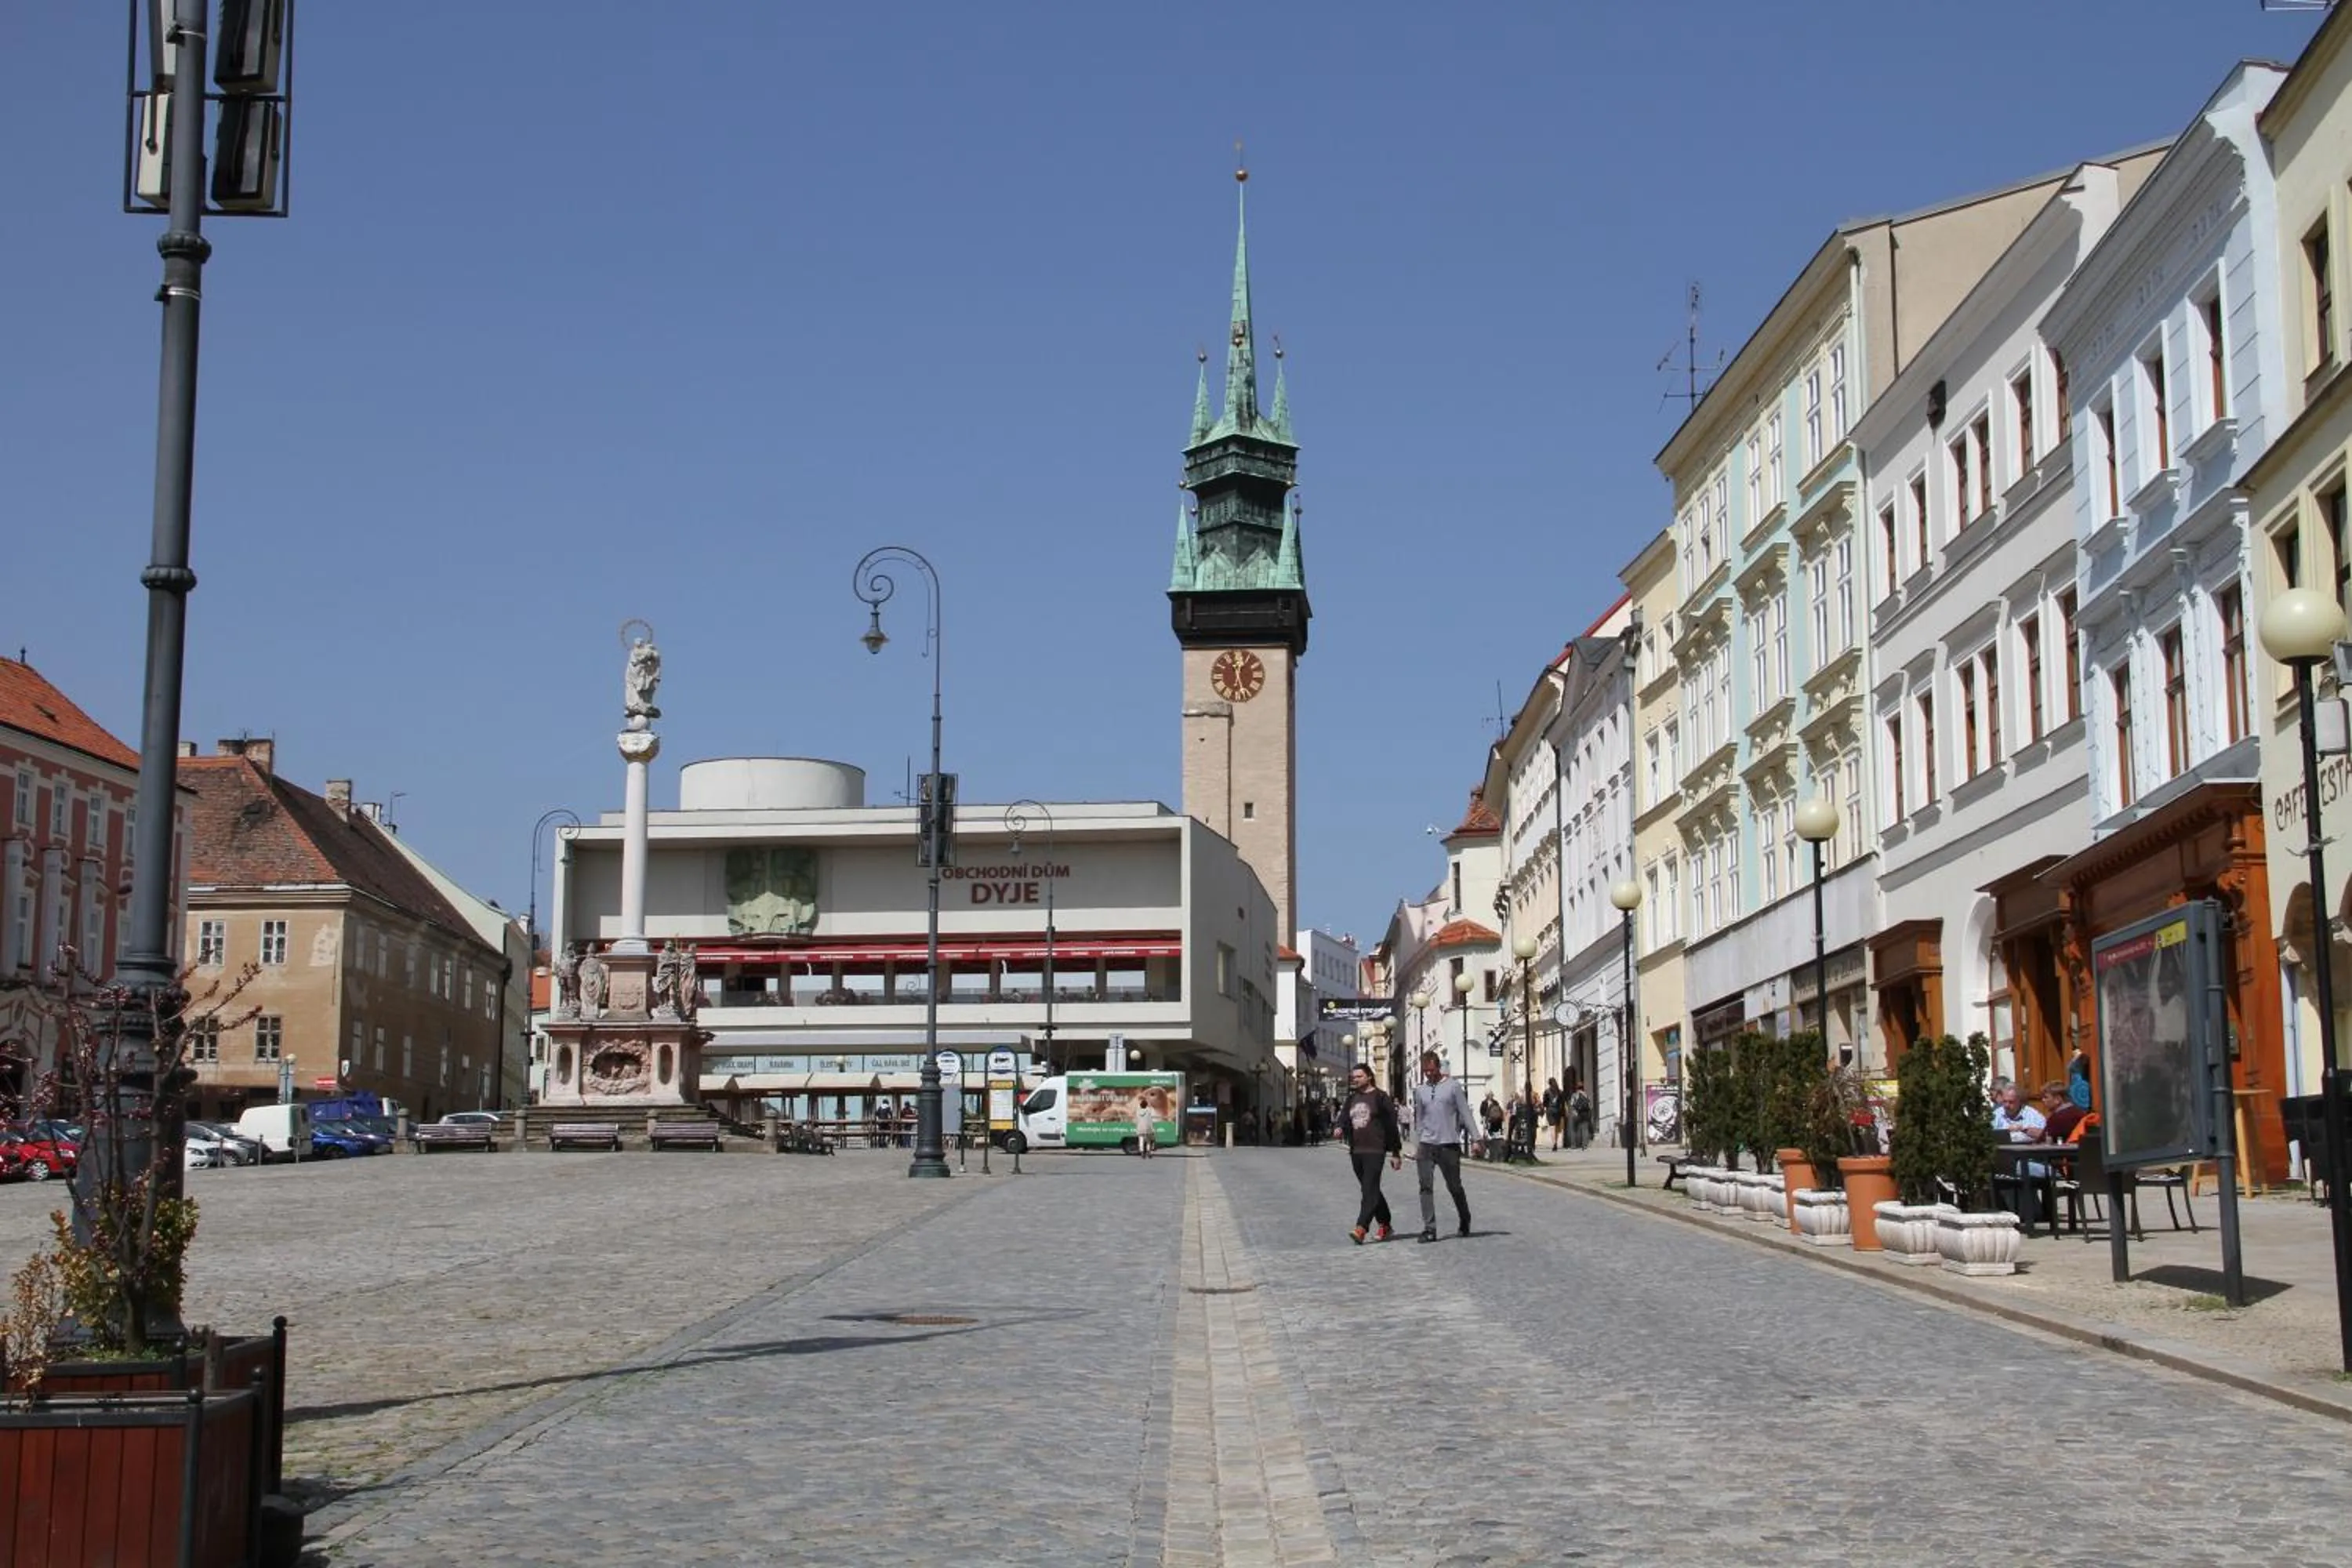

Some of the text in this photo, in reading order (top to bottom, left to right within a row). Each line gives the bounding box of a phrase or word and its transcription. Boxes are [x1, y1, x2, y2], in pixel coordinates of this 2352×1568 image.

[942, 862, 1070, 879] OBCHODNÍ DŮM
[971, 882, 1040, 903] DYJE
